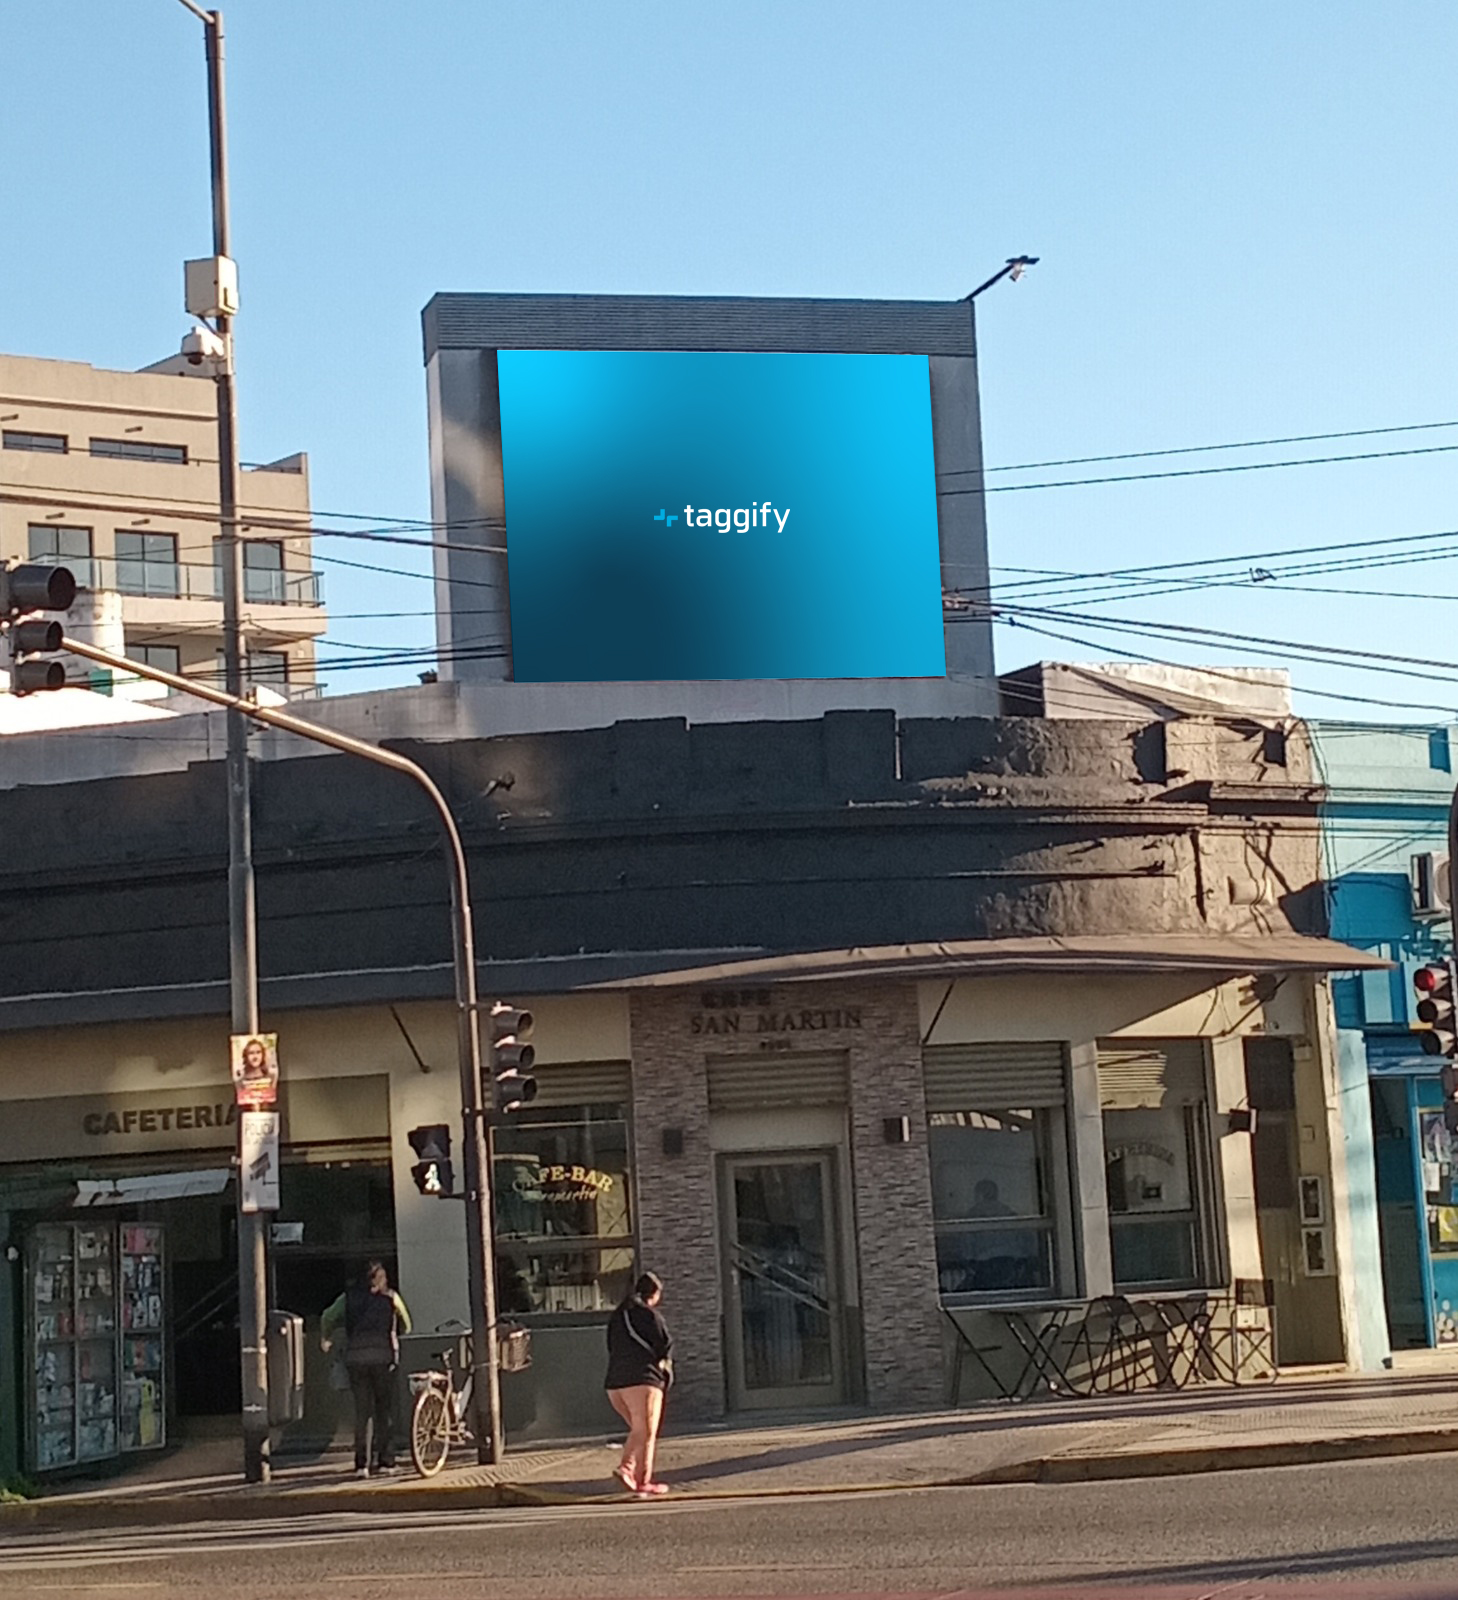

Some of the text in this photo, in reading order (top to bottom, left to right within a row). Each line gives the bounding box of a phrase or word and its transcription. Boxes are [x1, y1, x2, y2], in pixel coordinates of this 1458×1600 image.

[683, 501, 791, 534] taggify
[690, 1006, 863, 1035] SAN MARTIN
[82, 1103, 238, 1136] CAFETERIA
